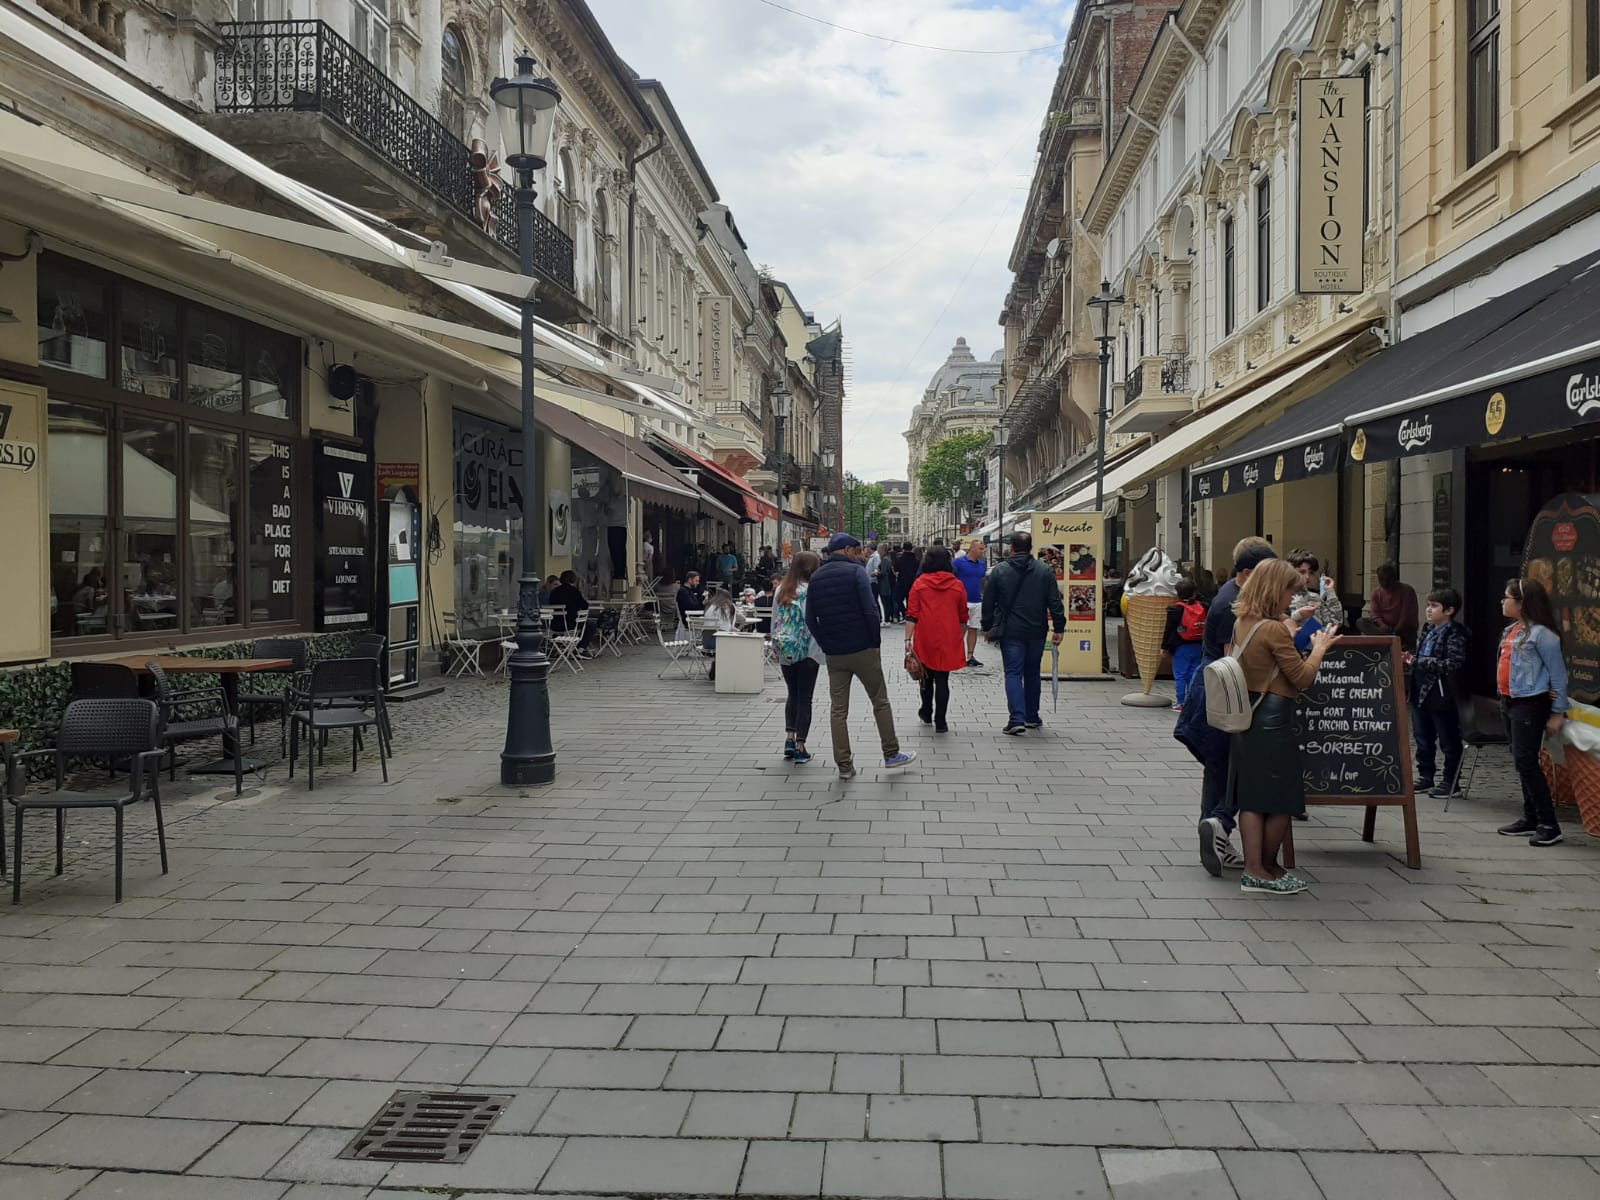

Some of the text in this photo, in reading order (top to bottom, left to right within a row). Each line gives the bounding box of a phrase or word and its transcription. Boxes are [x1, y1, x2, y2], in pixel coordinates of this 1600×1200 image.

[1320, 81, 1340, 95] the
[1318, 97, 1346, 265] MANSION
[712, 302, 721, 380] CONCORDE
[1398, 414, 1432, 447] Carlsberg
[271, 444, 290, 459] THIS
[282, 466, 290, 479] IS
[283, 485, 291, 499] A
[272, 504, 291, 519] BAD
[327, 499, 355, 516] VIBES
[265, 524, 291, 538] PLACE
[1053, 521, 1093, 537] peccato
[274, 544, 291, 558] FOR
[283, 560, 291, 574] A
[335, 575, 358, 584] LOUNGE
[272, 580, 291, 594] DIET
[1314, 671, 1364, 685] Artisanal
[1331, 688, 1383, 700] ICE CREAM
[1323, 707, 1345, 718] GOAT
[1352, 707, 1374, 719] MILK
[1308, 719, 1392, 732] & ORCHID EXTRACT
[1306, 741, 1383, 756] SORBETO
